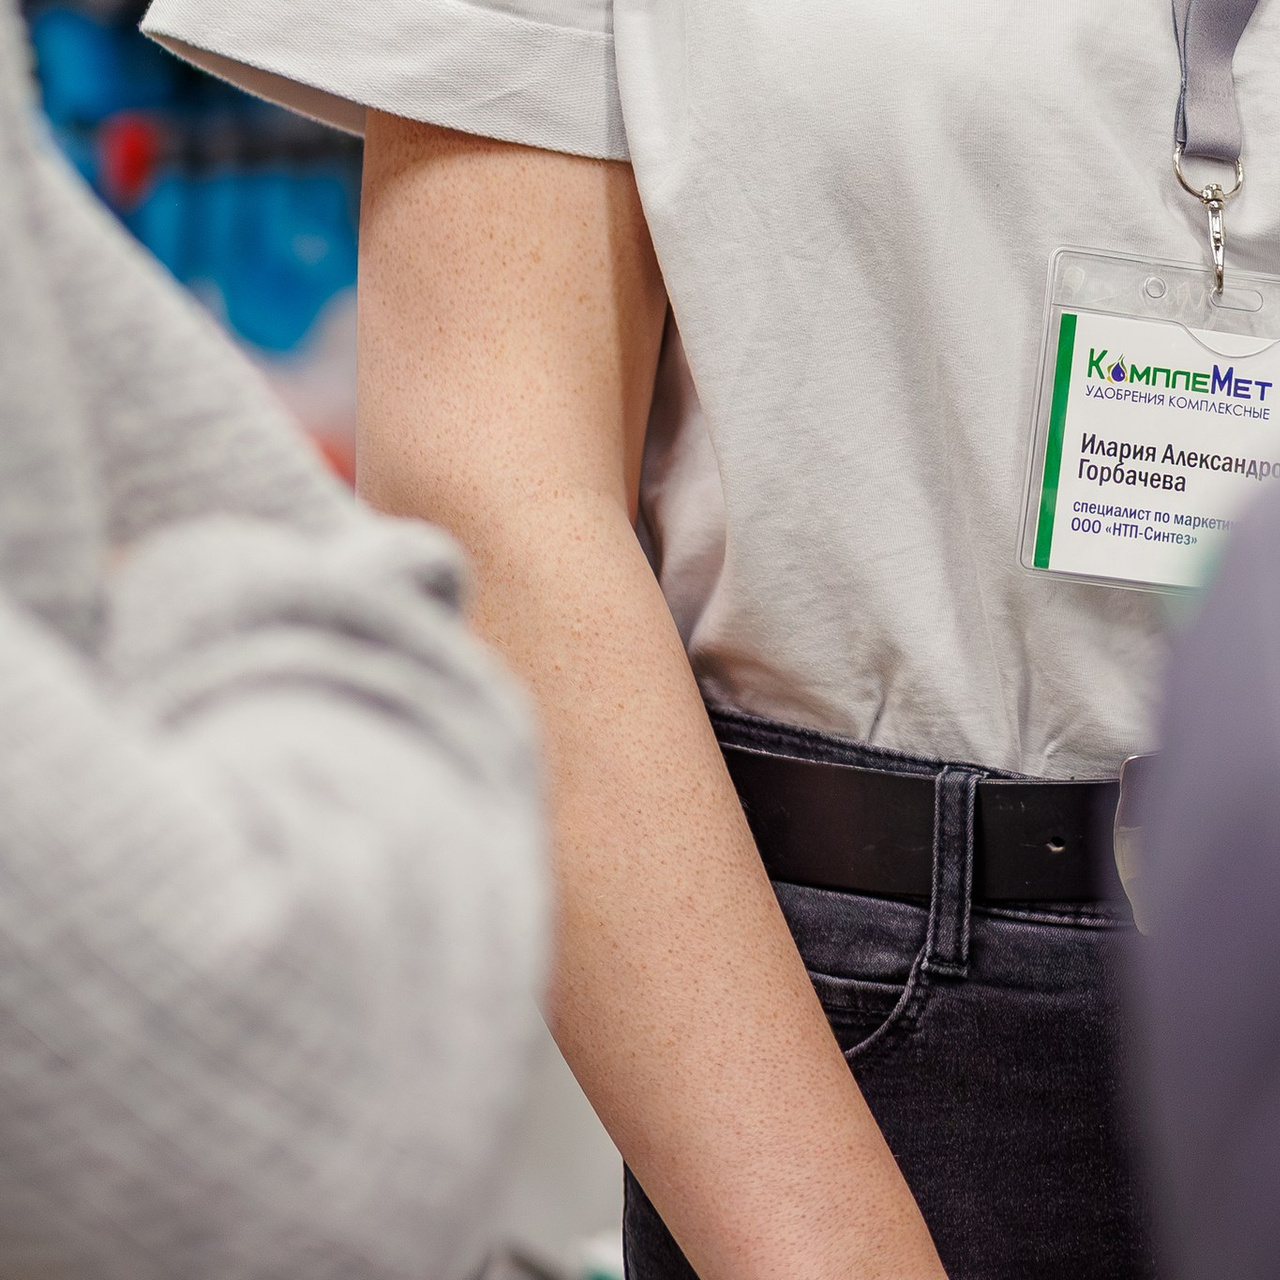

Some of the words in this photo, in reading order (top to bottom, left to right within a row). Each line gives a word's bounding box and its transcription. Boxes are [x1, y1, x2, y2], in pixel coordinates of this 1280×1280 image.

[1085, 385, 1165, 406] УДОБРЕНИЯ
[1168, 394, 1271, 421] КОМПЛЕКСНЫЕ
[1081, 432, 1157, 463] Илария
[1078, 458, 1187, 492] Горбачева
[1073, 500, 1152, 522] специалист
[1154, 511, 1171, 524] по
[1071, 517, 1102, 534] ООО
[1105, 522, 1198, 546] «НТП-Синтез»
